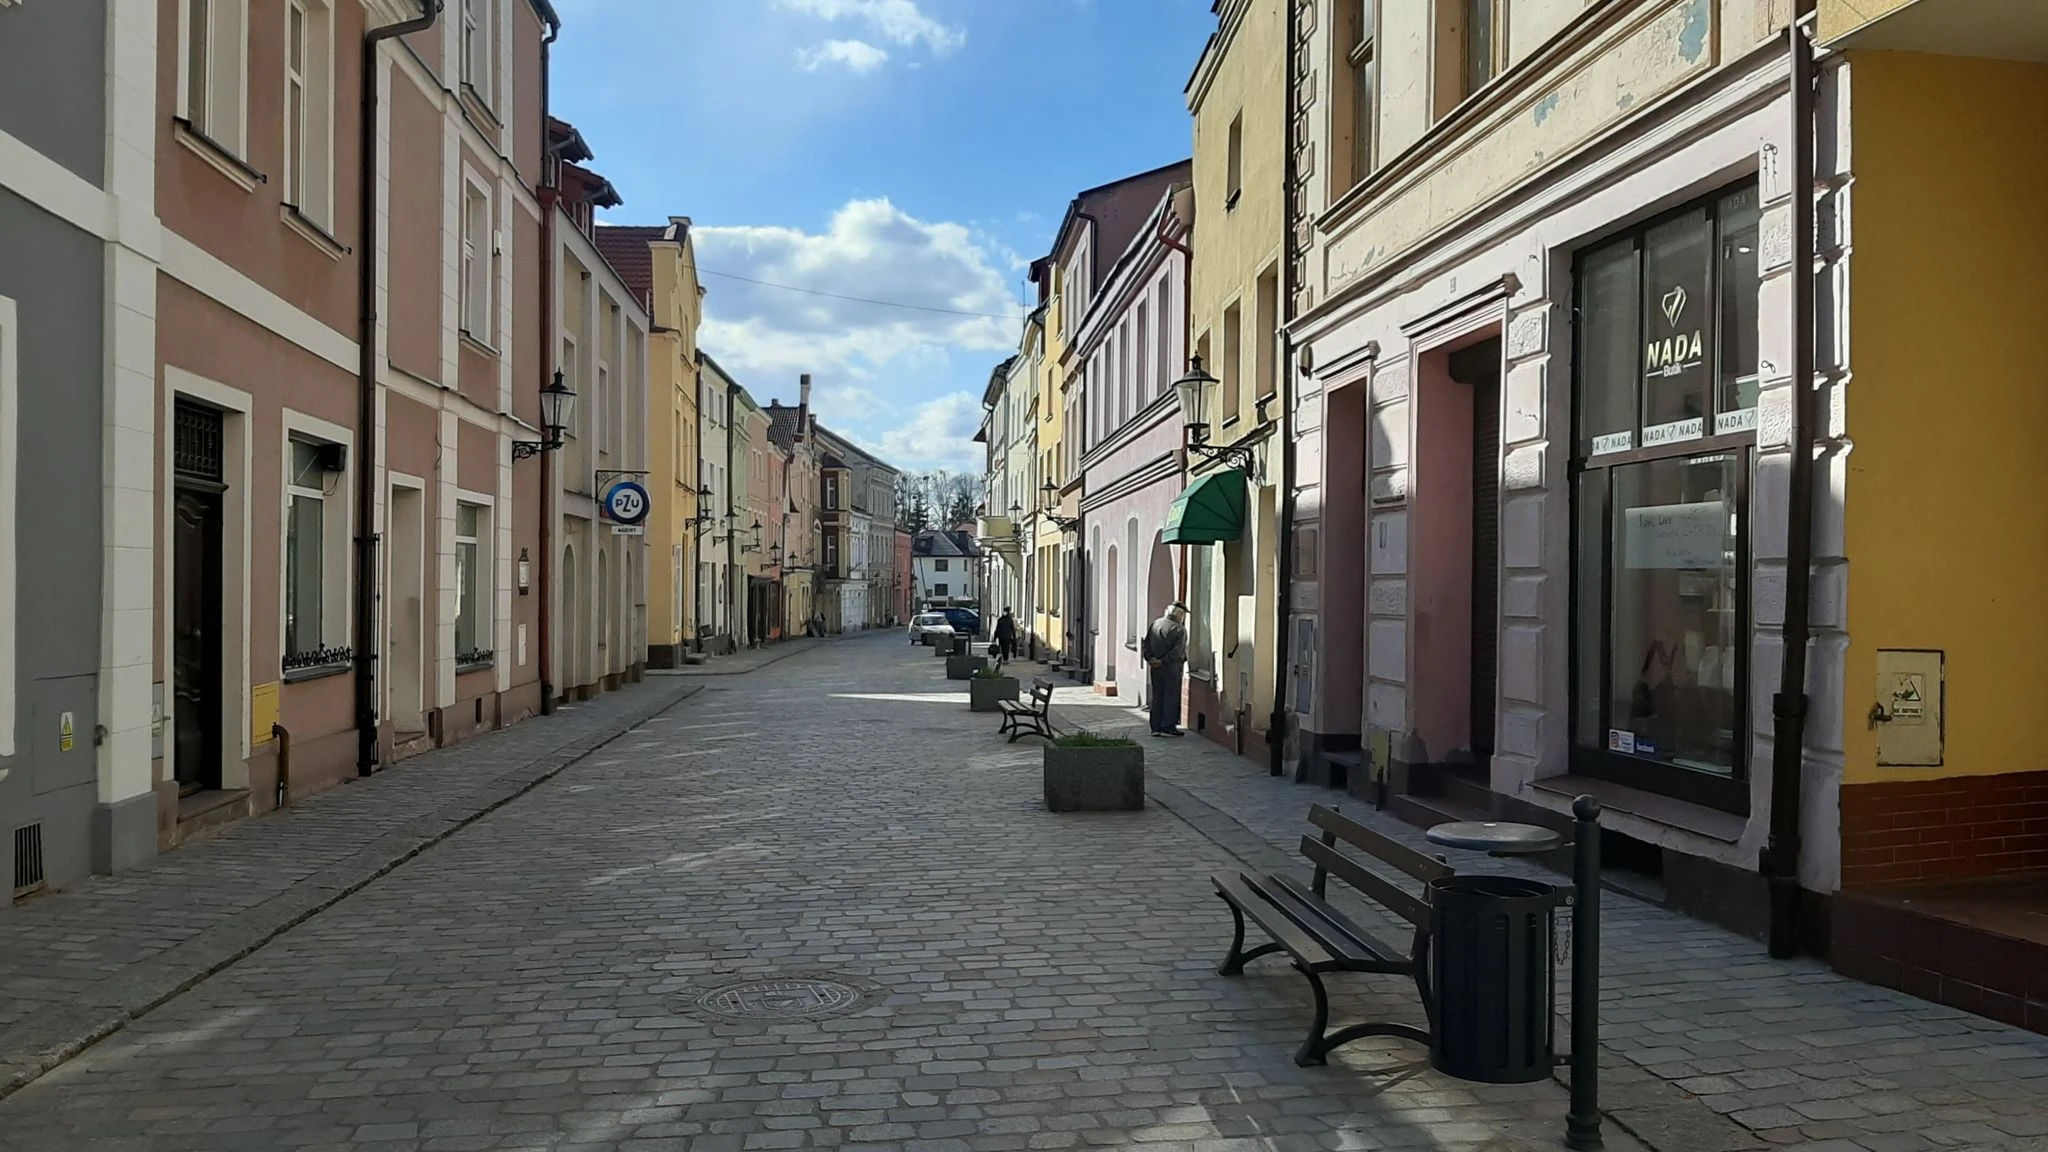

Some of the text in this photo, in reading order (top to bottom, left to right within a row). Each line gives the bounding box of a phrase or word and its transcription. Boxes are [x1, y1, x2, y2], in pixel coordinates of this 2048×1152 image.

[1646, 329, 1702, 369] NADA
[1663, 363, 1682, 377] Butik
[1717, 414, 1743, 430] NADA
[1643, 421, 1703, 443] NADA NADA
[615, 495, 640, 512] PZU
